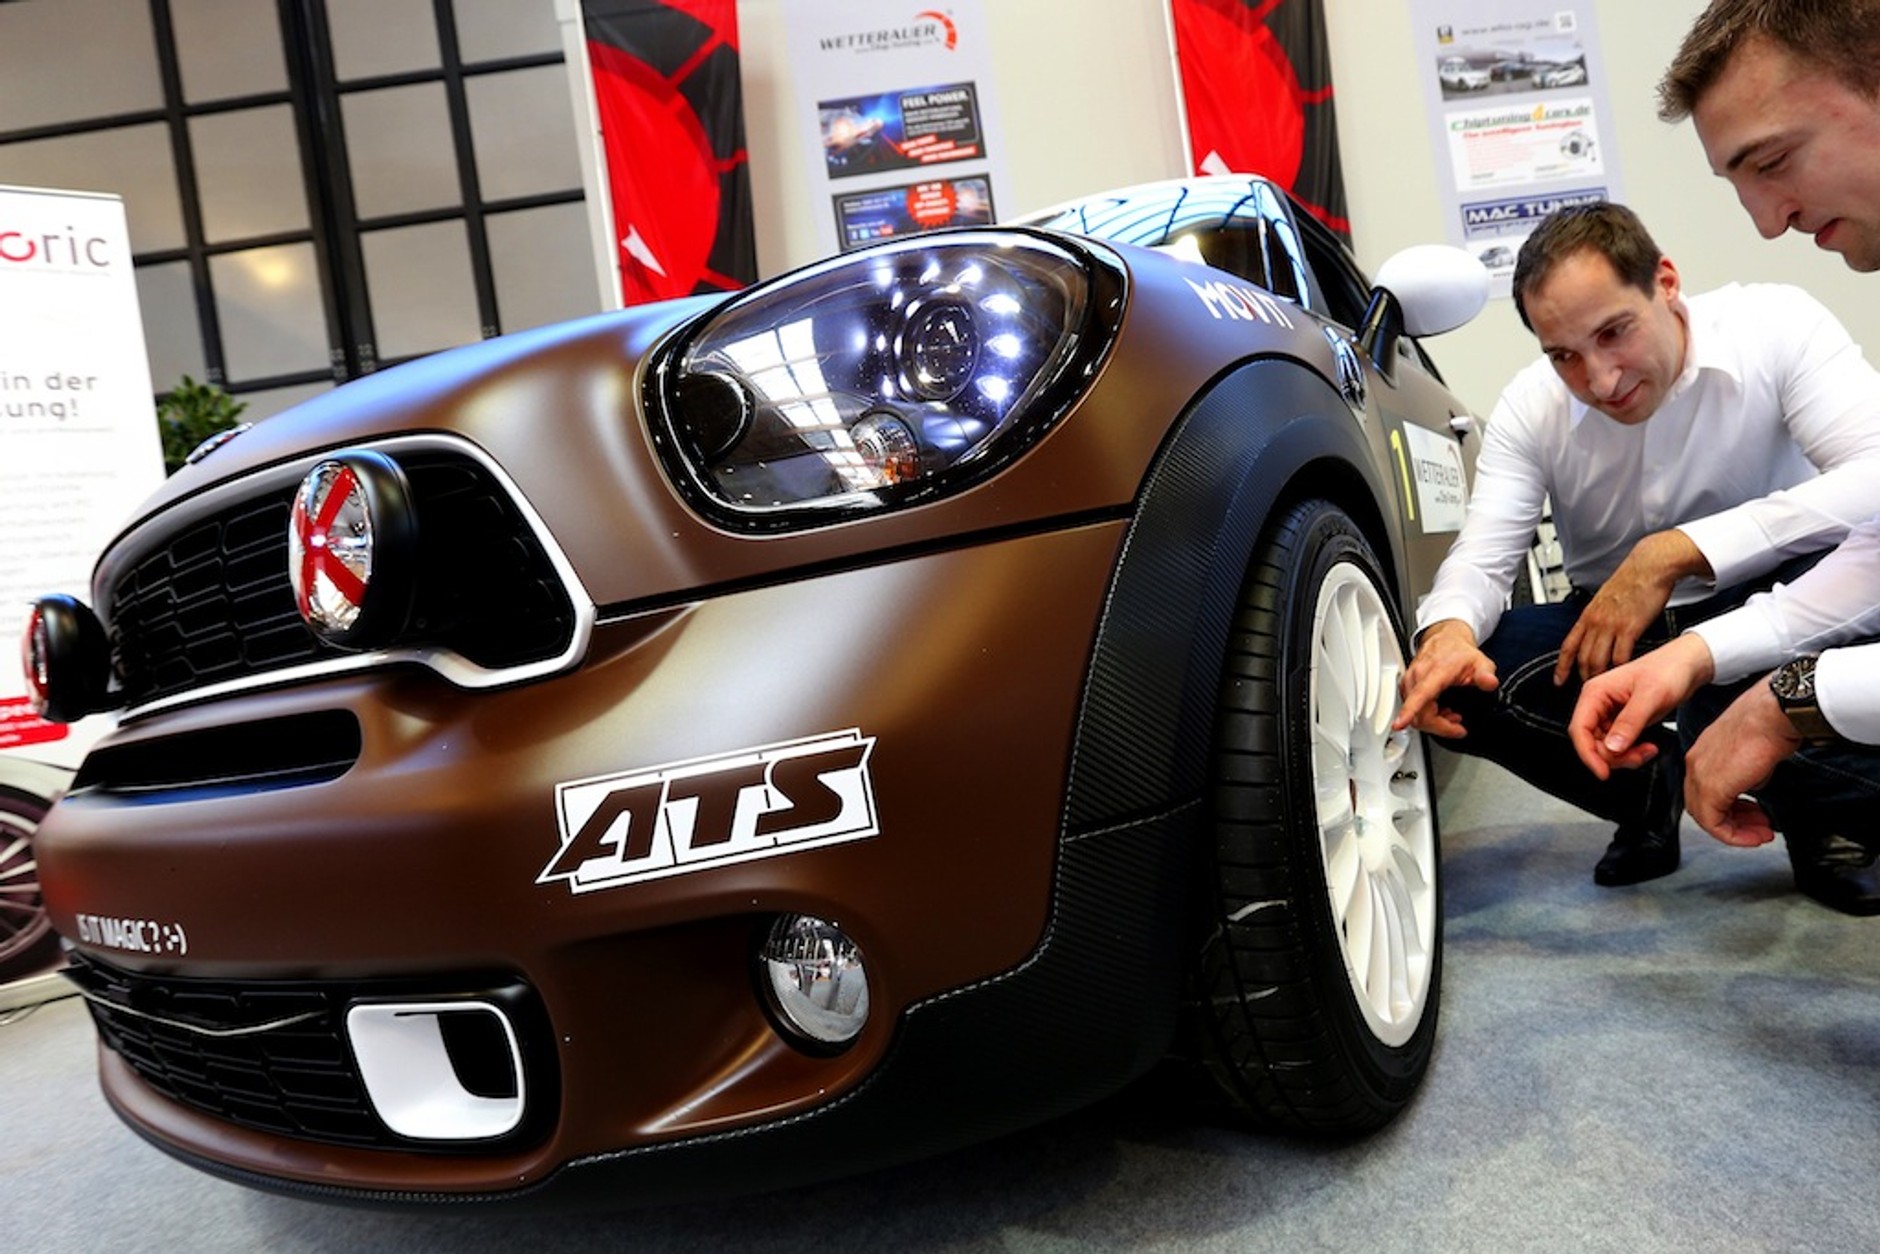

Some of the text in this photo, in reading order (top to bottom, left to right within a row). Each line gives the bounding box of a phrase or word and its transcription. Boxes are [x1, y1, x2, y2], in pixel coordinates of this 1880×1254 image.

[820, 24, 936, 50] WETTERAUER
[1468, 204, 1520, 224] MAC
[45, 371, 98, 391] der
[0, 398, 79, 422] ung!
[1390, 429, 1415, 521] 1
[544, 743, 868, 876] ATS
[87, 915, 102, 945] IT
